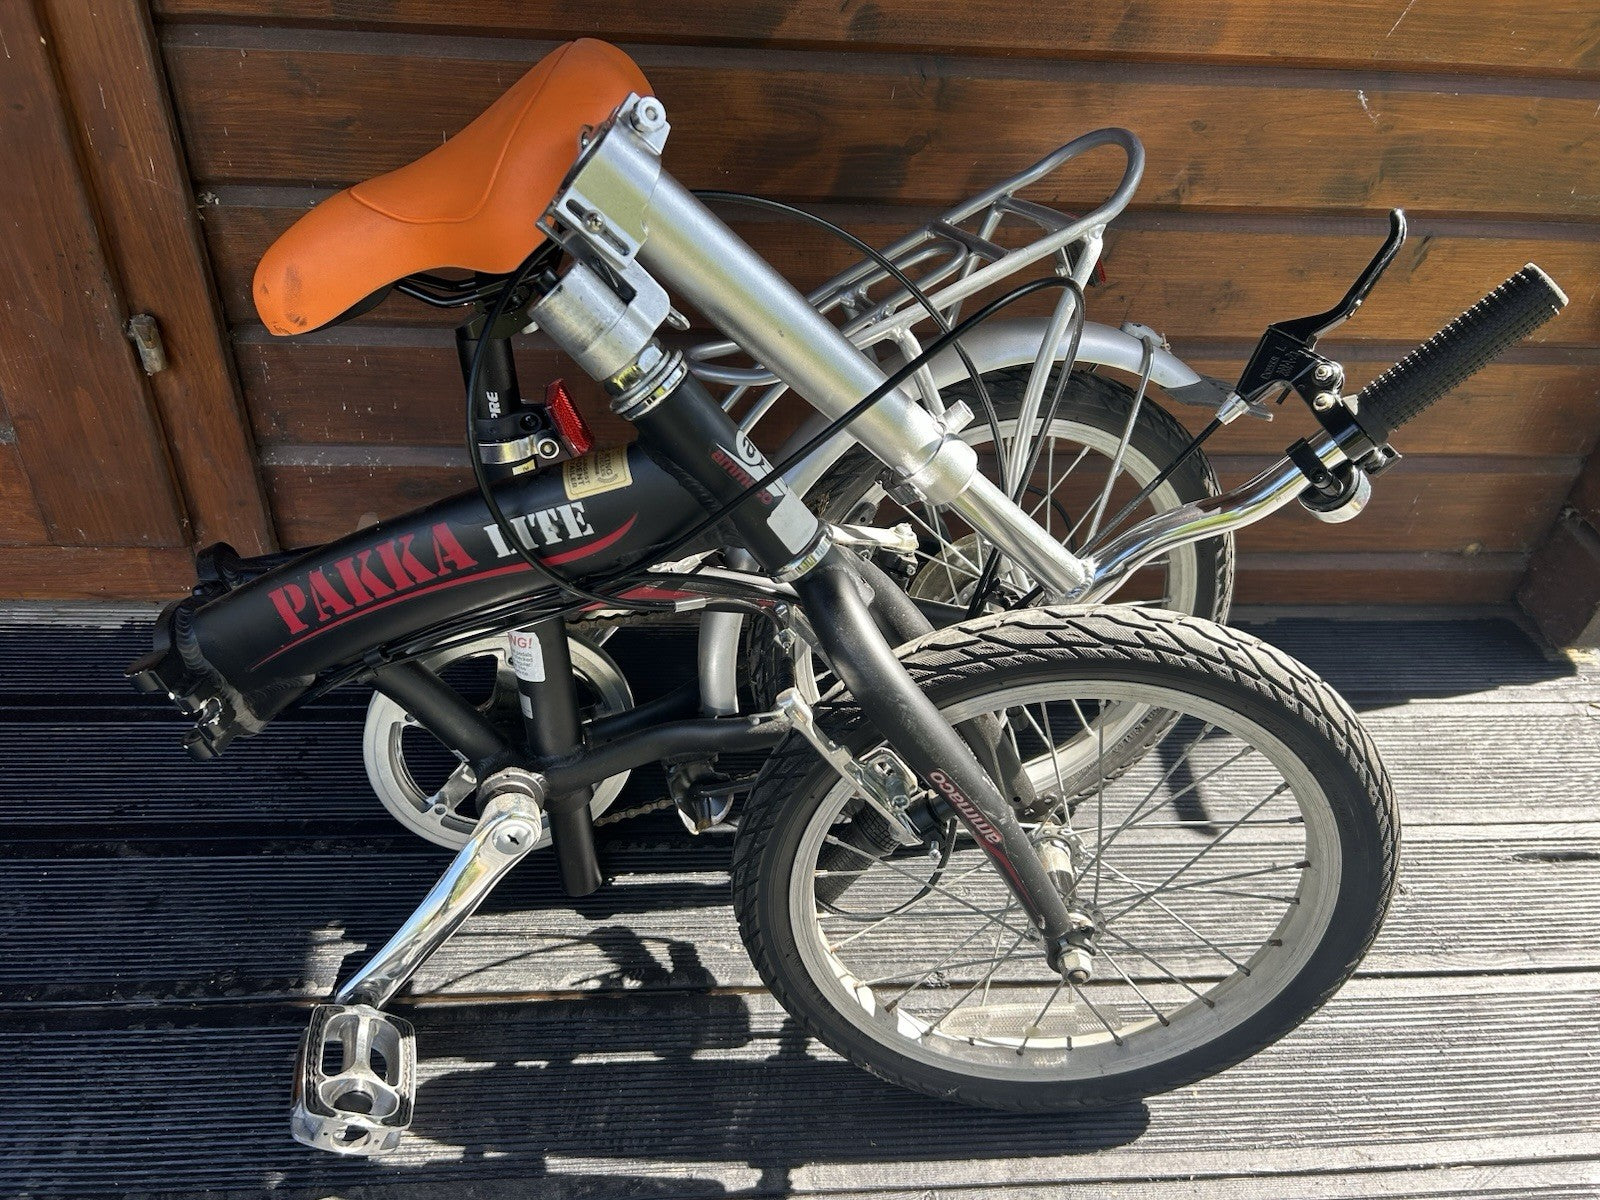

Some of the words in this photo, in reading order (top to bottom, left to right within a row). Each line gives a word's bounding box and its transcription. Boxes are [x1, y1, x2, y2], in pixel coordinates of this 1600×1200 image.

[268, 522, 478, 634] PAKKA
[483, 501, 595, 558] LITE
[929, 771, 1001, 843] ammaco
